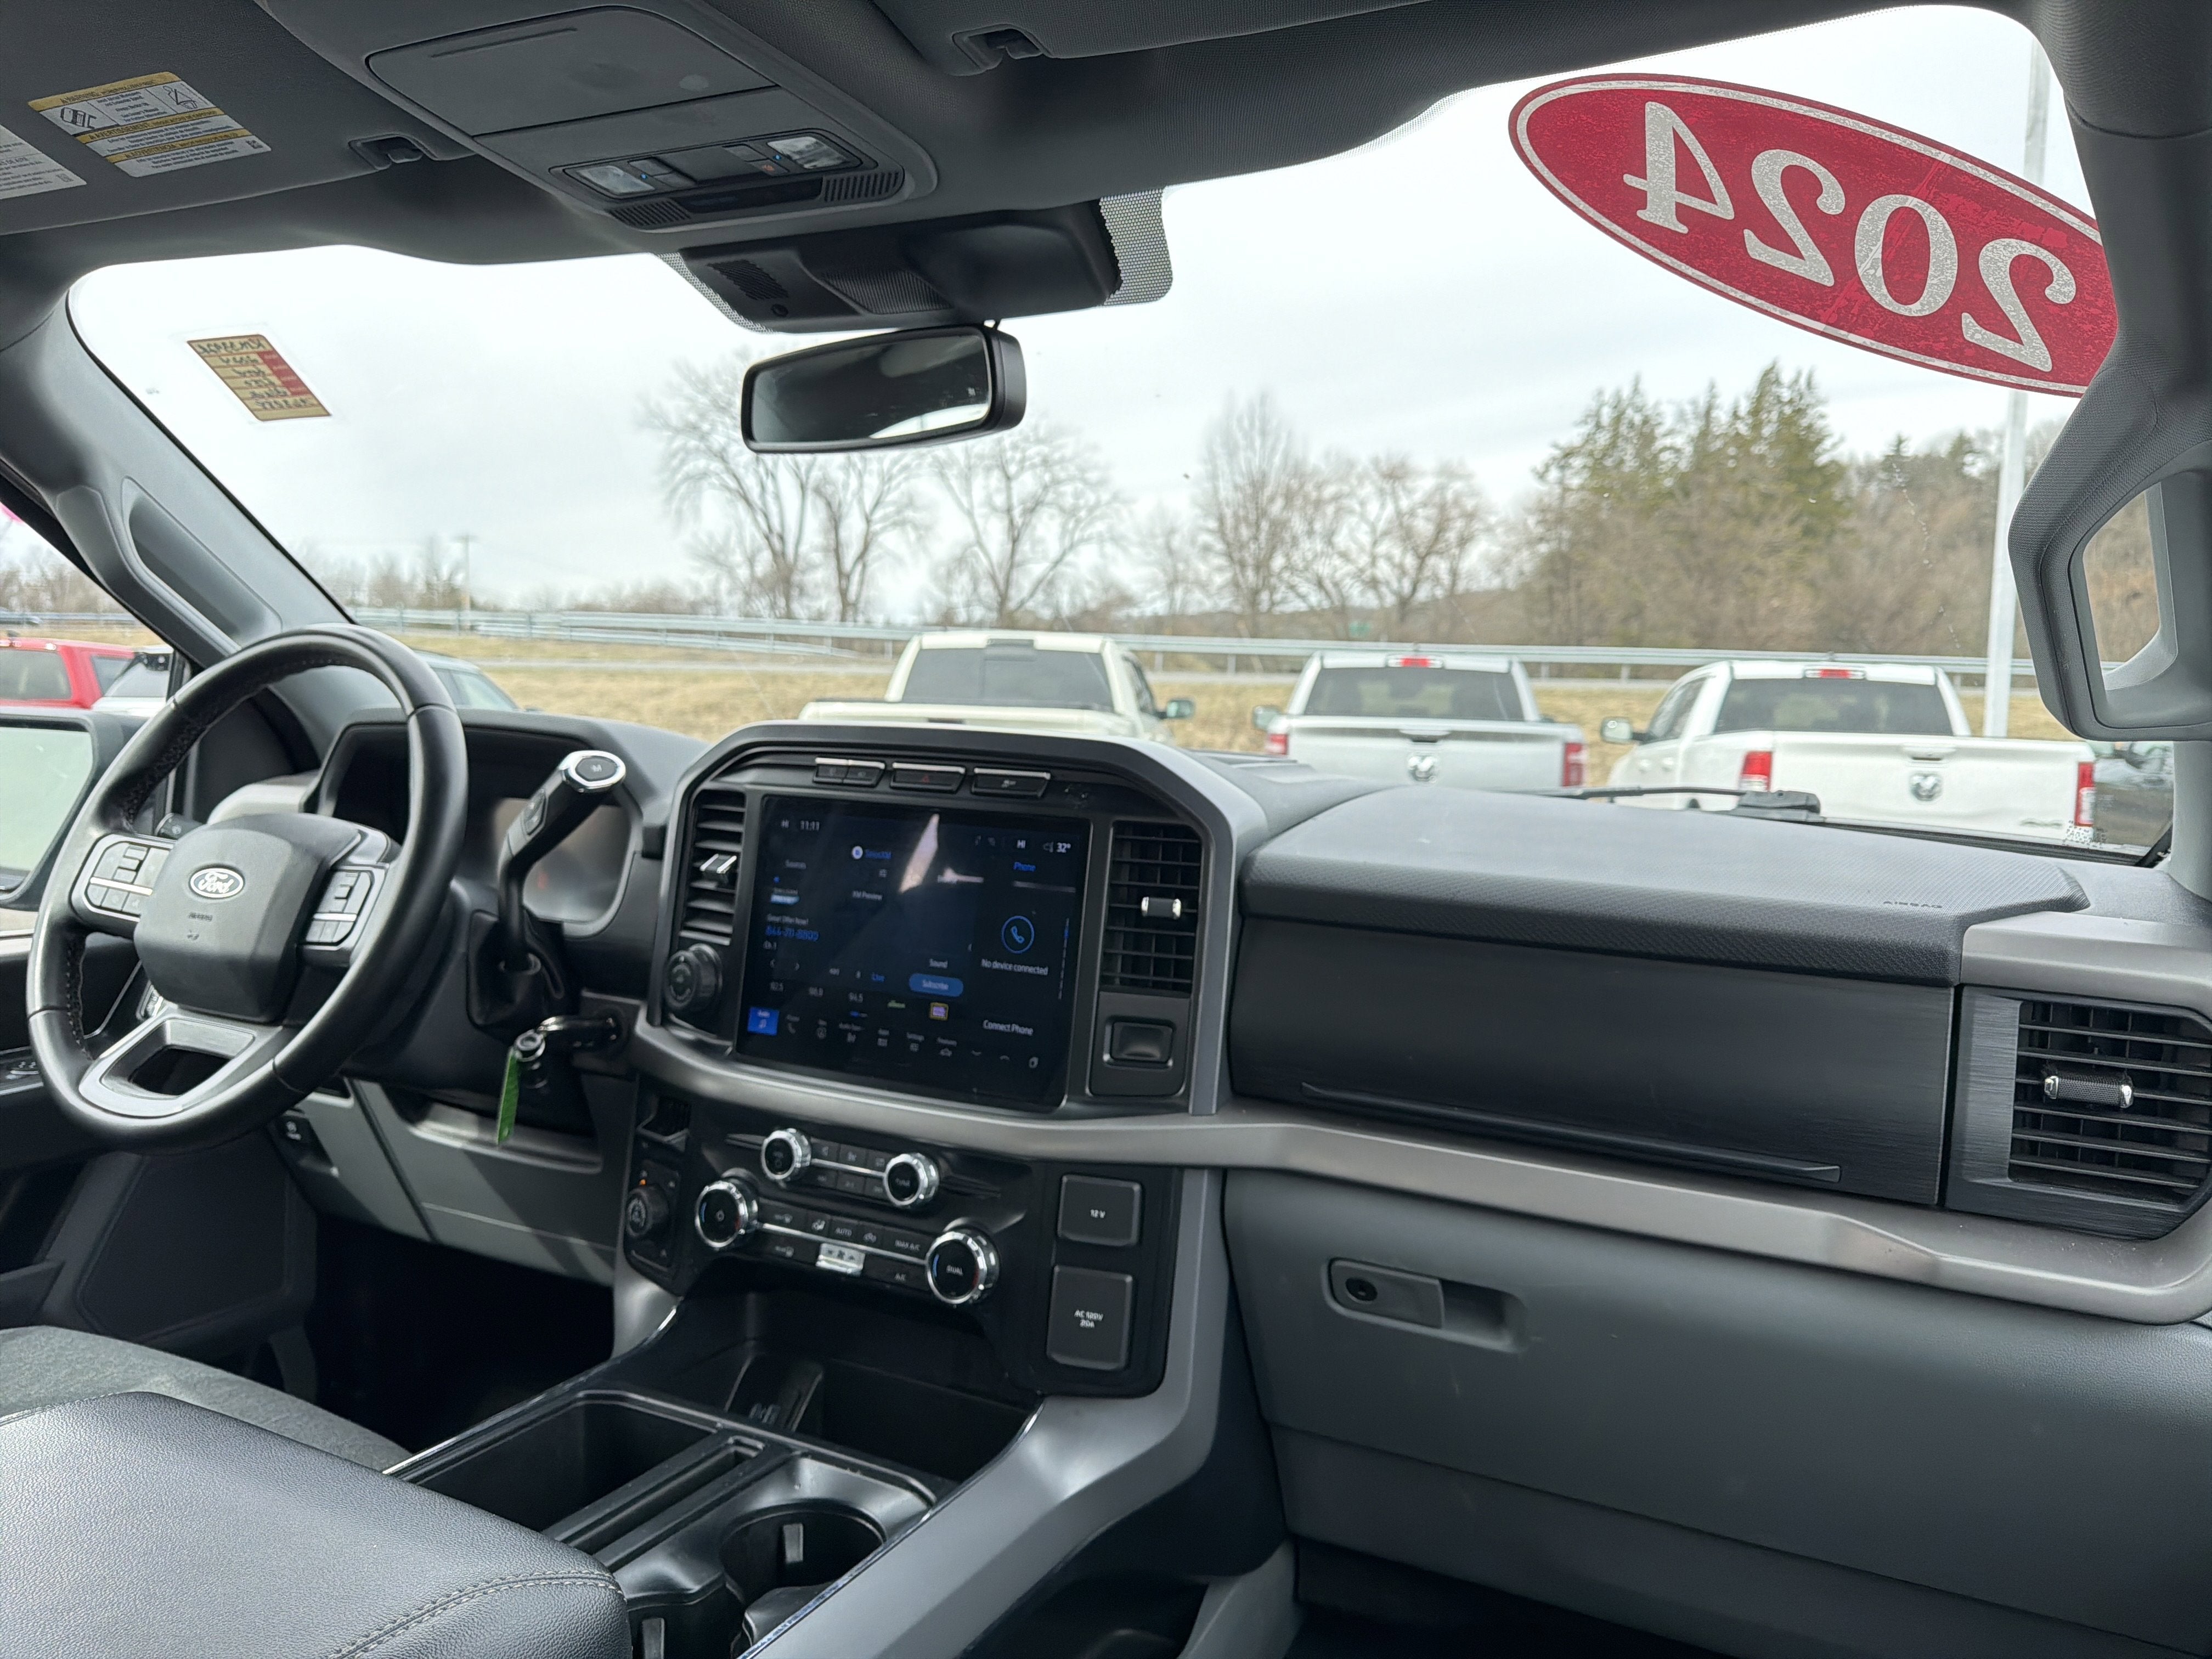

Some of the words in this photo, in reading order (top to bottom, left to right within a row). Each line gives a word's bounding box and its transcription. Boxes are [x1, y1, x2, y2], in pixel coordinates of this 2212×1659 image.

[198, 871, 235, 894] Ford
[992, 960, 1013, 972] device
[1014, 964, 1048, 975] connected
[983, 1019, 1011, 1032] Connect
[1011, 1023, 1034, 1036] Phone
